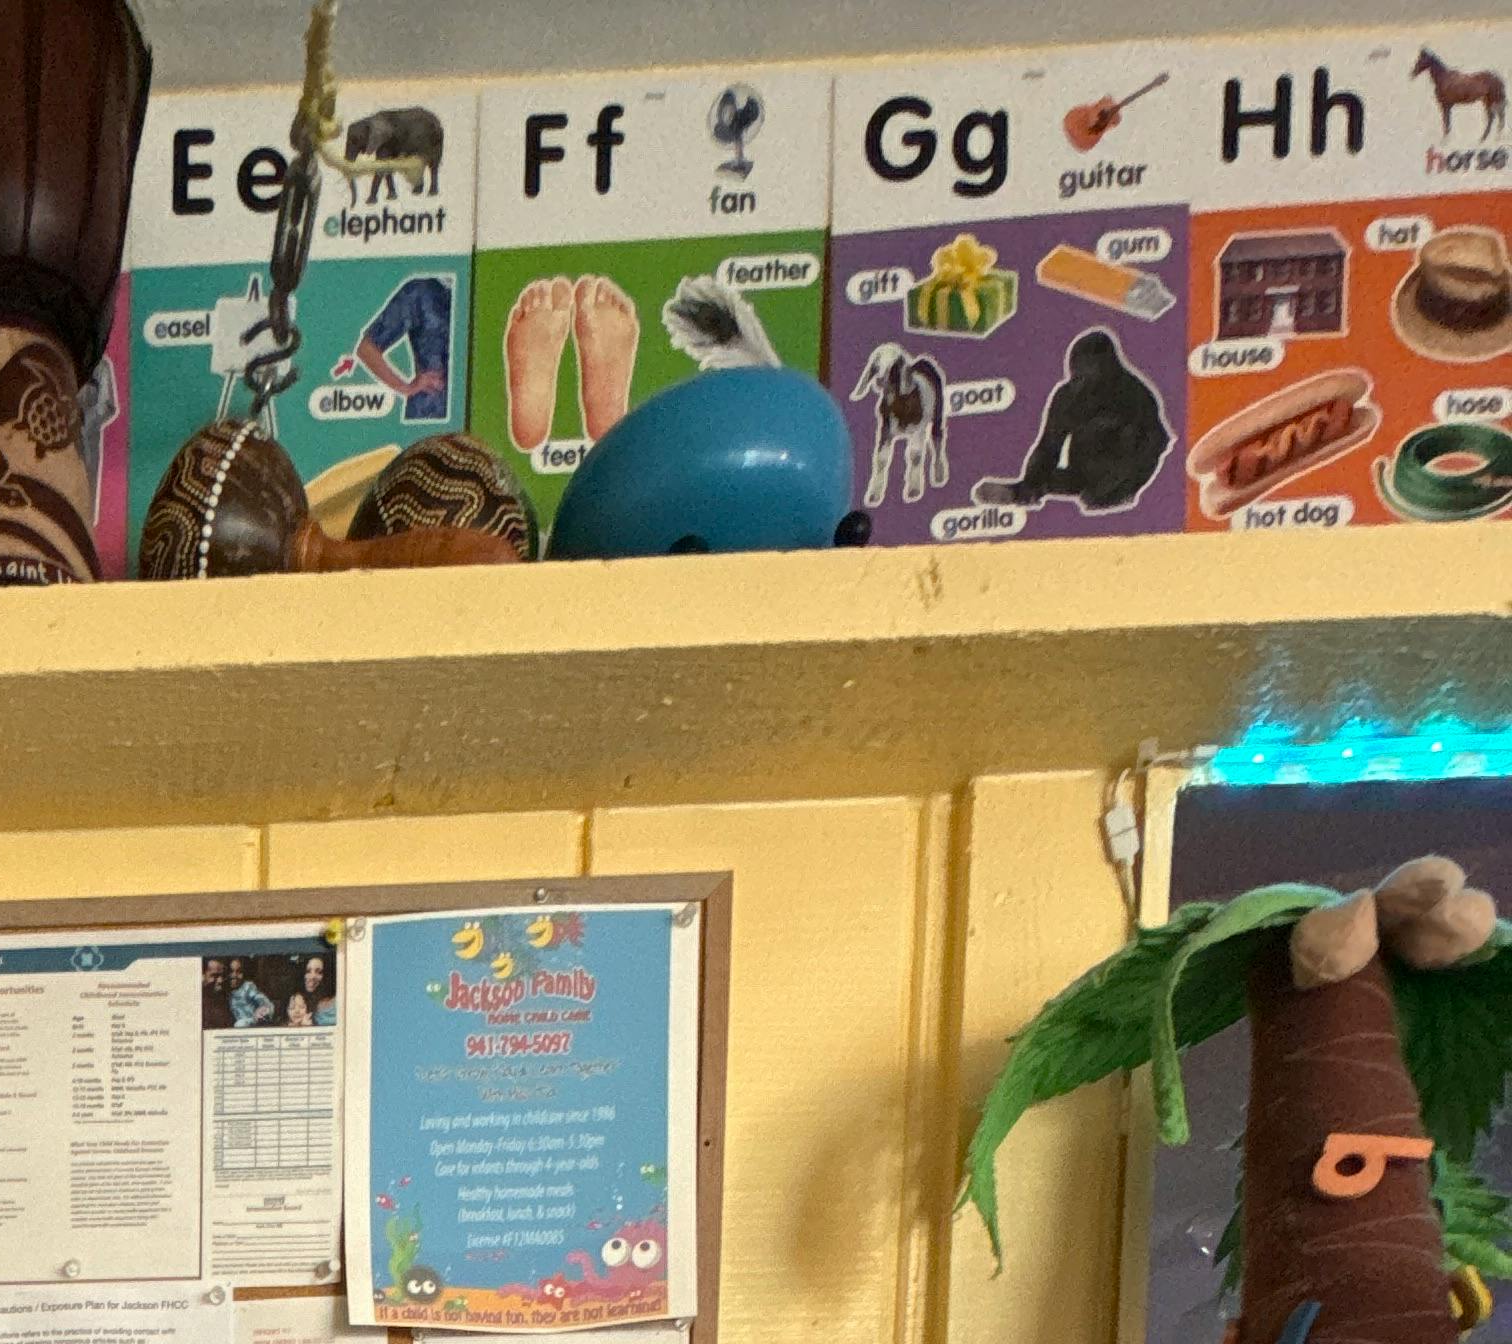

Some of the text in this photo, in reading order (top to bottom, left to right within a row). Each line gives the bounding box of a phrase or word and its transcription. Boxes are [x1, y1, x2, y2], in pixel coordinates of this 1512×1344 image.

[1222, 67, 1364, 162] Hh
[866, 96, 1008, 197] Gg
[1425, 146, 1508, 176] horse
[1059, 161, 1148, 198] guitar
[709, 188, 756, 214] fan
[323, 208, 446, 238] elephant
[1378, 222, 1422, 246] hat
[1108, 232, 1160, 258] gum
[726, 258, 811, 285] feather
[859, 271, 901, 297] gift
[154, 315, 211, 339] easel
[1201, 344, 1273, 368] house
[318, 391, 384, 413] elbow
[950, 383, 1005, 409] goat
[1445, 393, 1500, 417] hose
[541, 446, 586, 466] feet
[942, 507, 1015, 535] gorilla
[1245, 500, 1339, 528] hot dog
[445, 965, 597, 1013] Jackson Family
